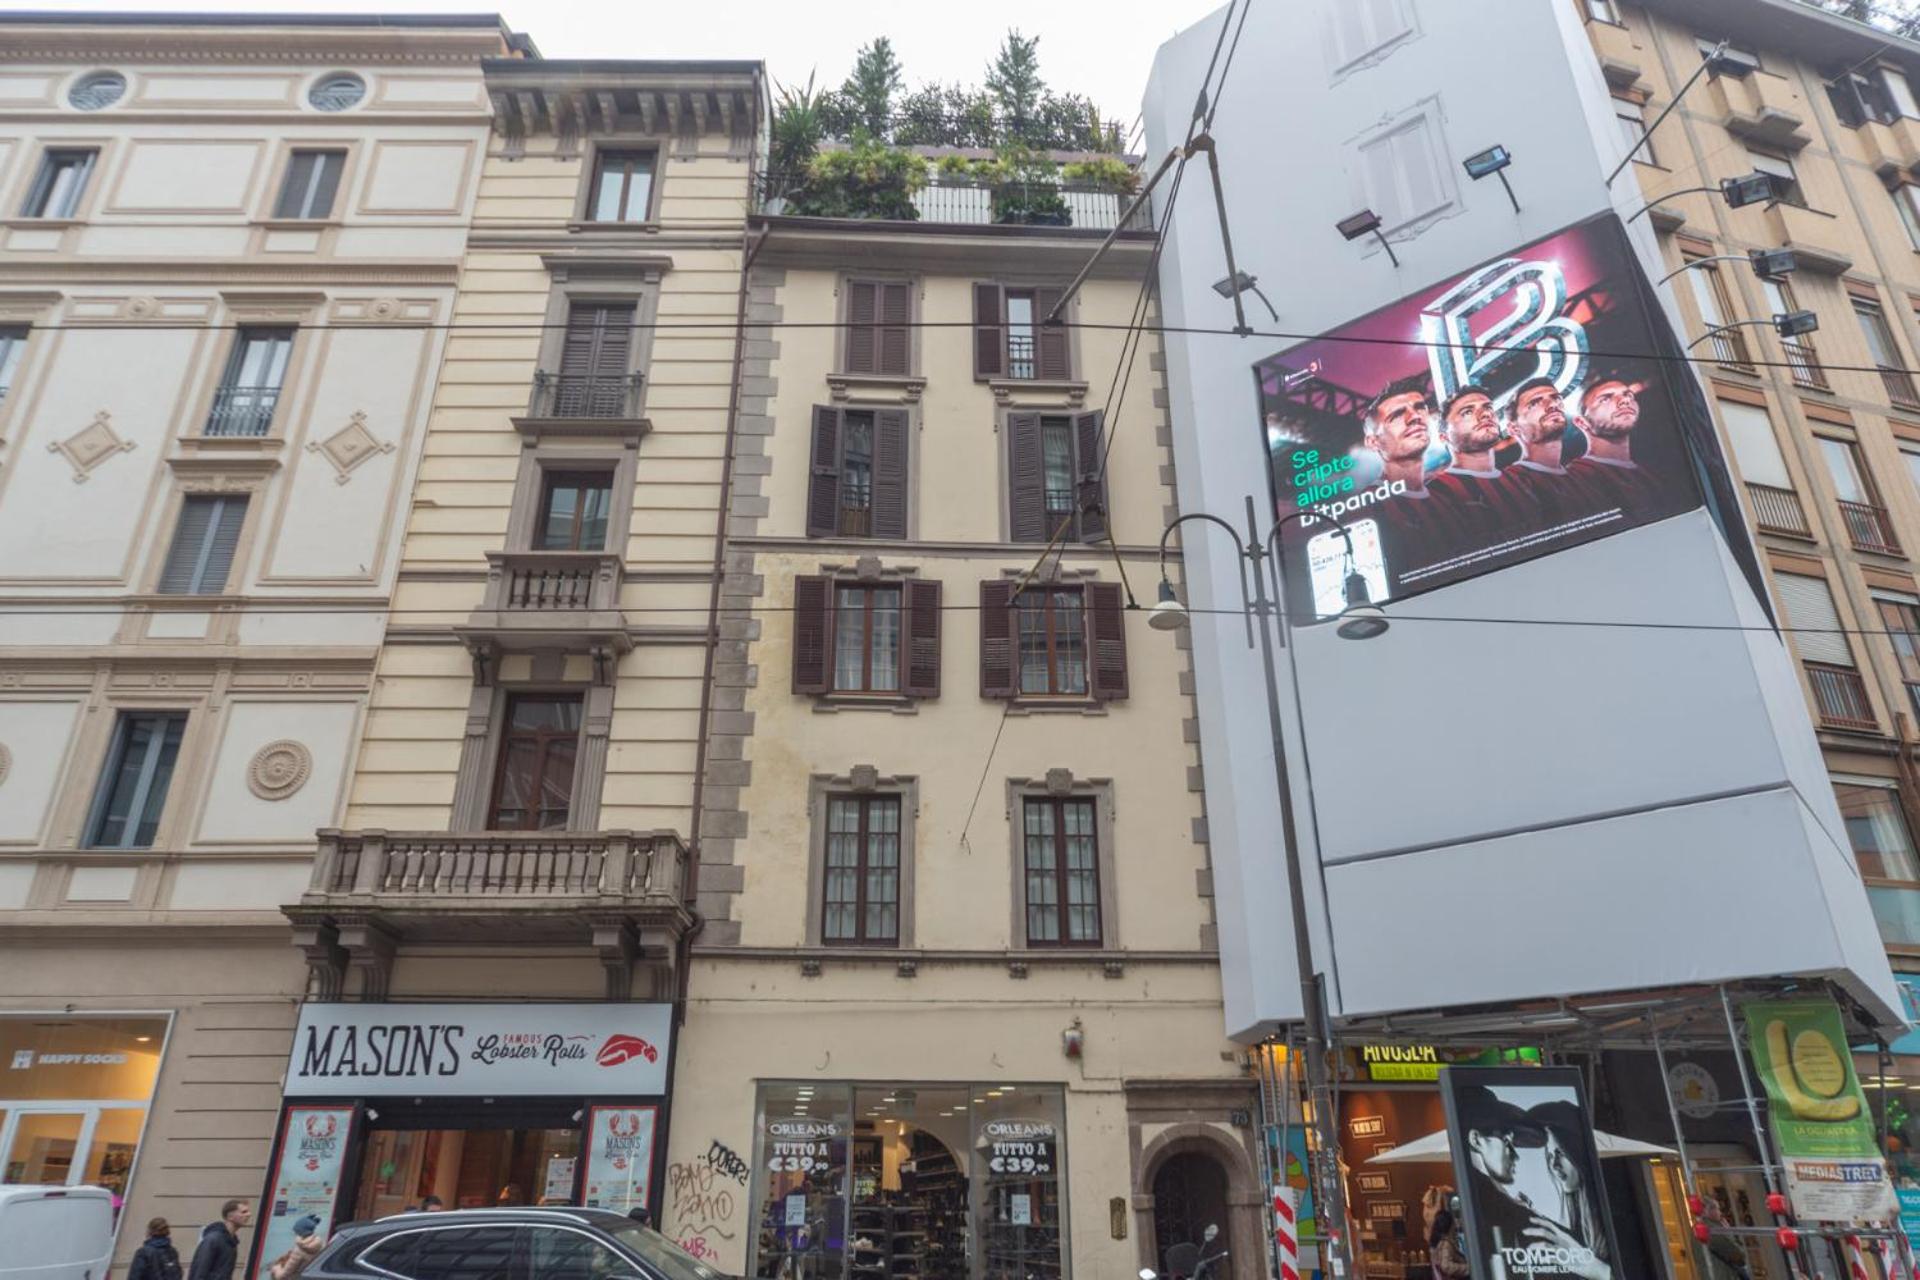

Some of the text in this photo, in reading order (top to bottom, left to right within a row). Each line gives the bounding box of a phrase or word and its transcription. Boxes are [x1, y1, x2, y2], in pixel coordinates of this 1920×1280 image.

[1292, 450, 1319, 469] Se
[1295, 455, 1354, 487] cripto
[1298, 477, 1354, 507] allora
[1300, 480, 1407, 527] bitpanda
[503, 1034, 542, 1044] FAMOUS
[299, 1025, 463, 1077] MASON'S
[471, 1034, 588, 1067] Lobster Rolls
[770, 1123, 837, 1135] ORLEANS
[987, 1123, 1054, 1135] ORLEANS
[774, 1143, 828, 1155] TUTTO A
[993, 1143, 1047, 1155] TUTTO A
[1502, 1248, 1595, 1265] TOM FORD
